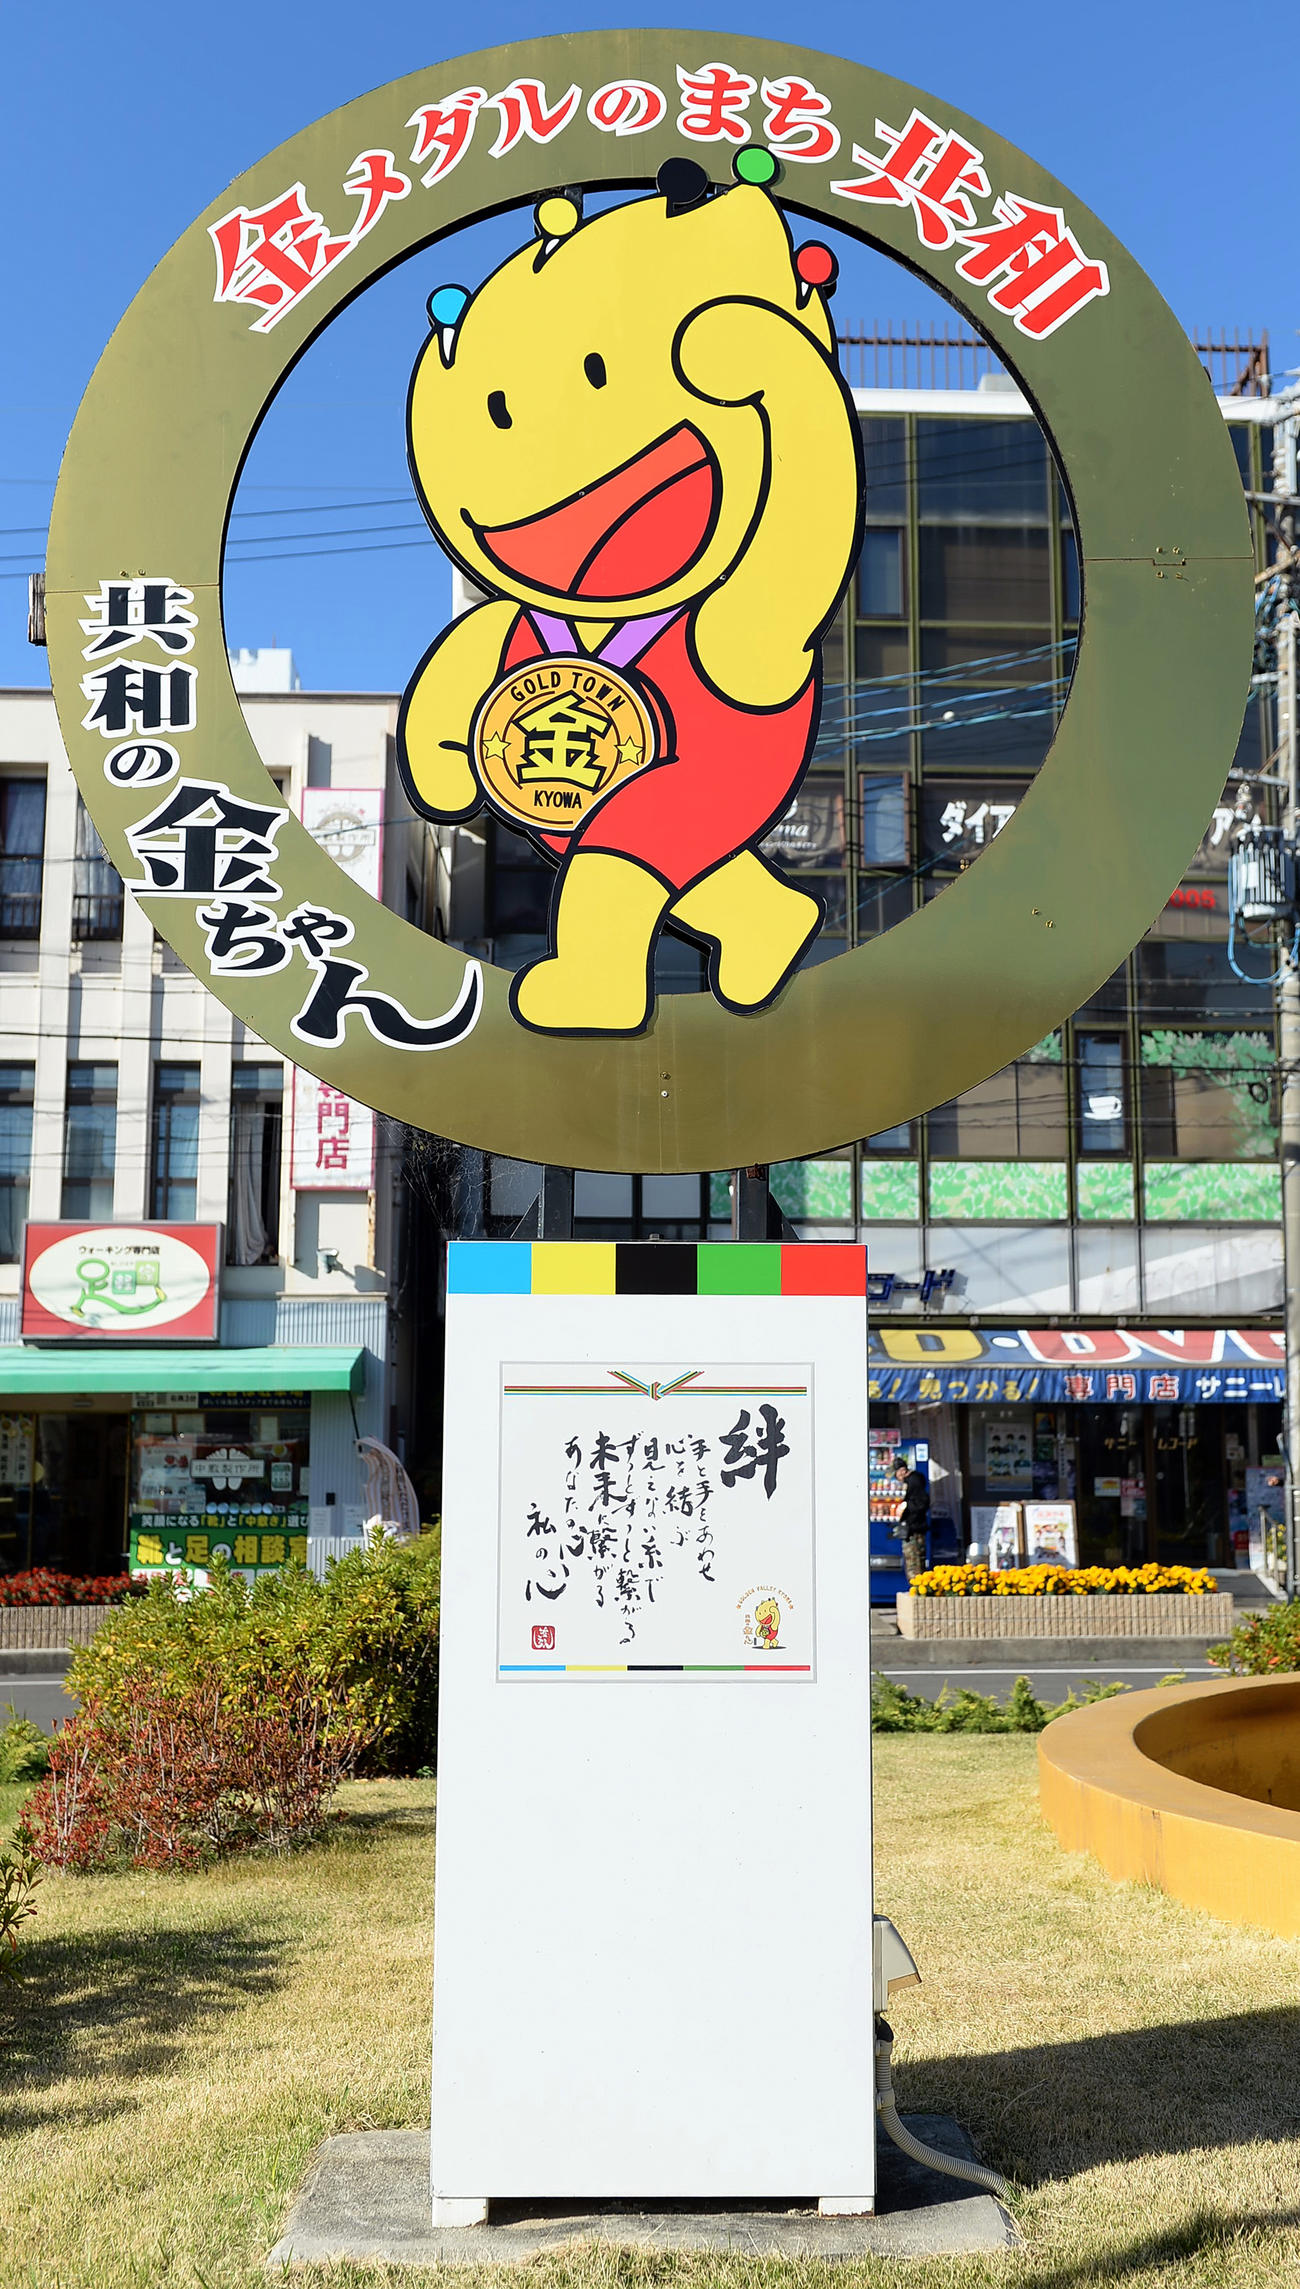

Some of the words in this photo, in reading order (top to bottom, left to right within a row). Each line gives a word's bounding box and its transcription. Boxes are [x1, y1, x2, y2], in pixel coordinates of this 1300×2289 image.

[510, 671, 561, 702] GOLD
[571, 671, 626, 712] TOWN
[511, 689, 613, 793] 金
[78, 577, 484, 1052] 共和の金ちゃん
[533, 789, 583, 809] KYOWA
[1064, 1373, 1180, 1400] 専門店
[718, 1403, 790, 1500] 絆
